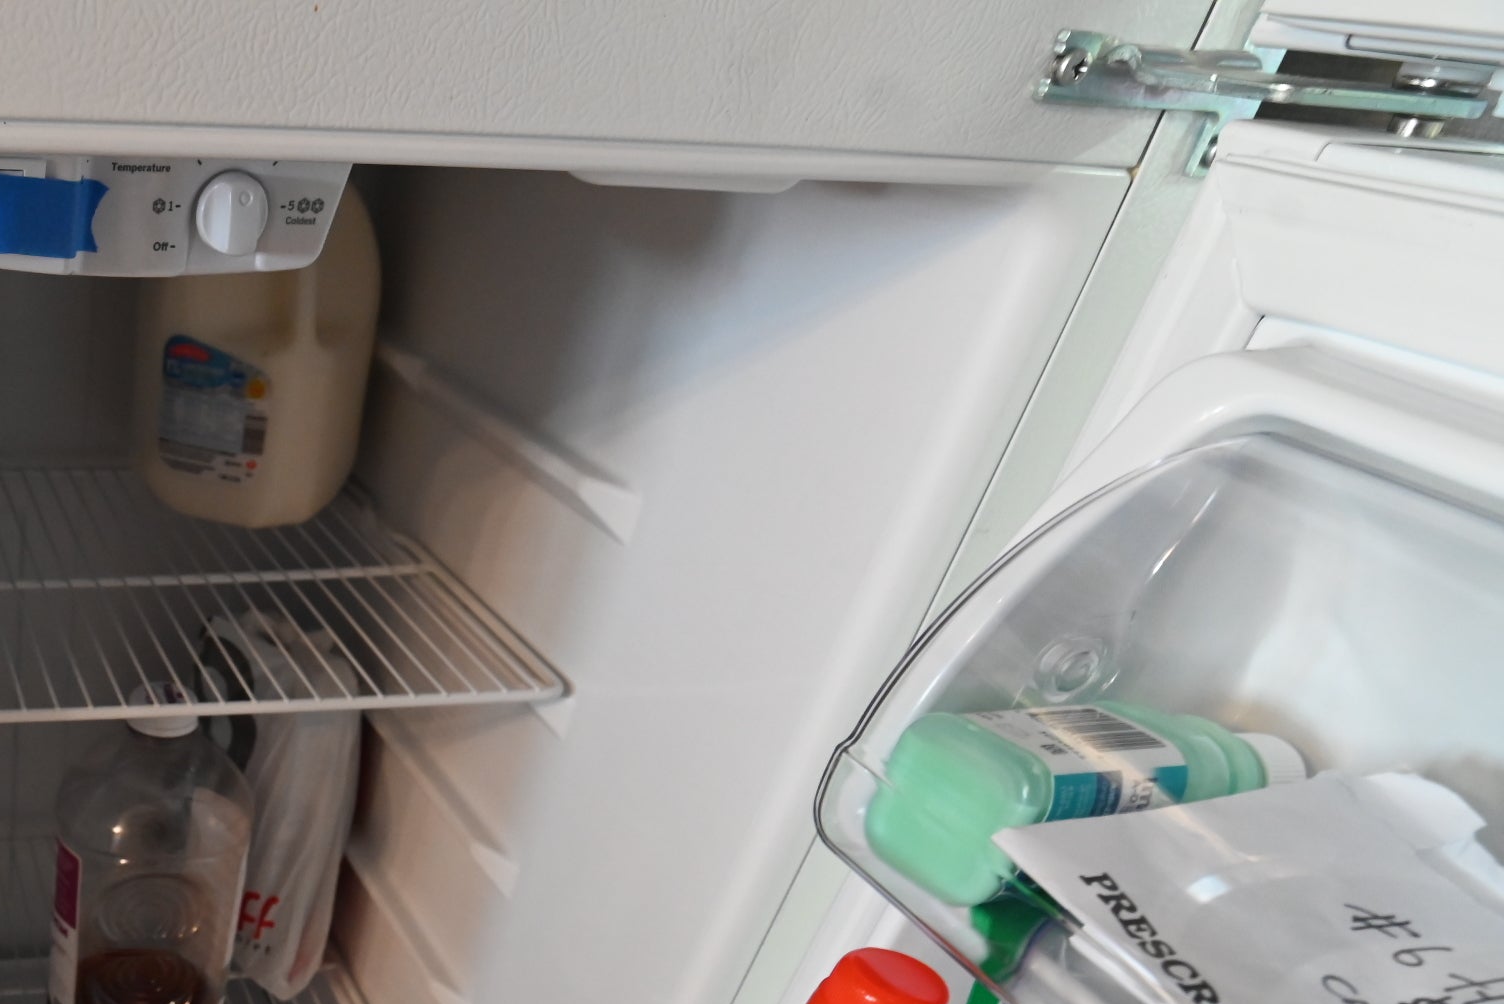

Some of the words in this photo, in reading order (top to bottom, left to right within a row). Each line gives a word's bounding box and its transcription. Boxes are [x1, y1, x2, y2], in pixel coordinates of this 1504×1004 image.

[112, 162, 171, 174] Temperature
[285, 216, 316, 225] Coldest
[153, 241, 168, 251] Off
